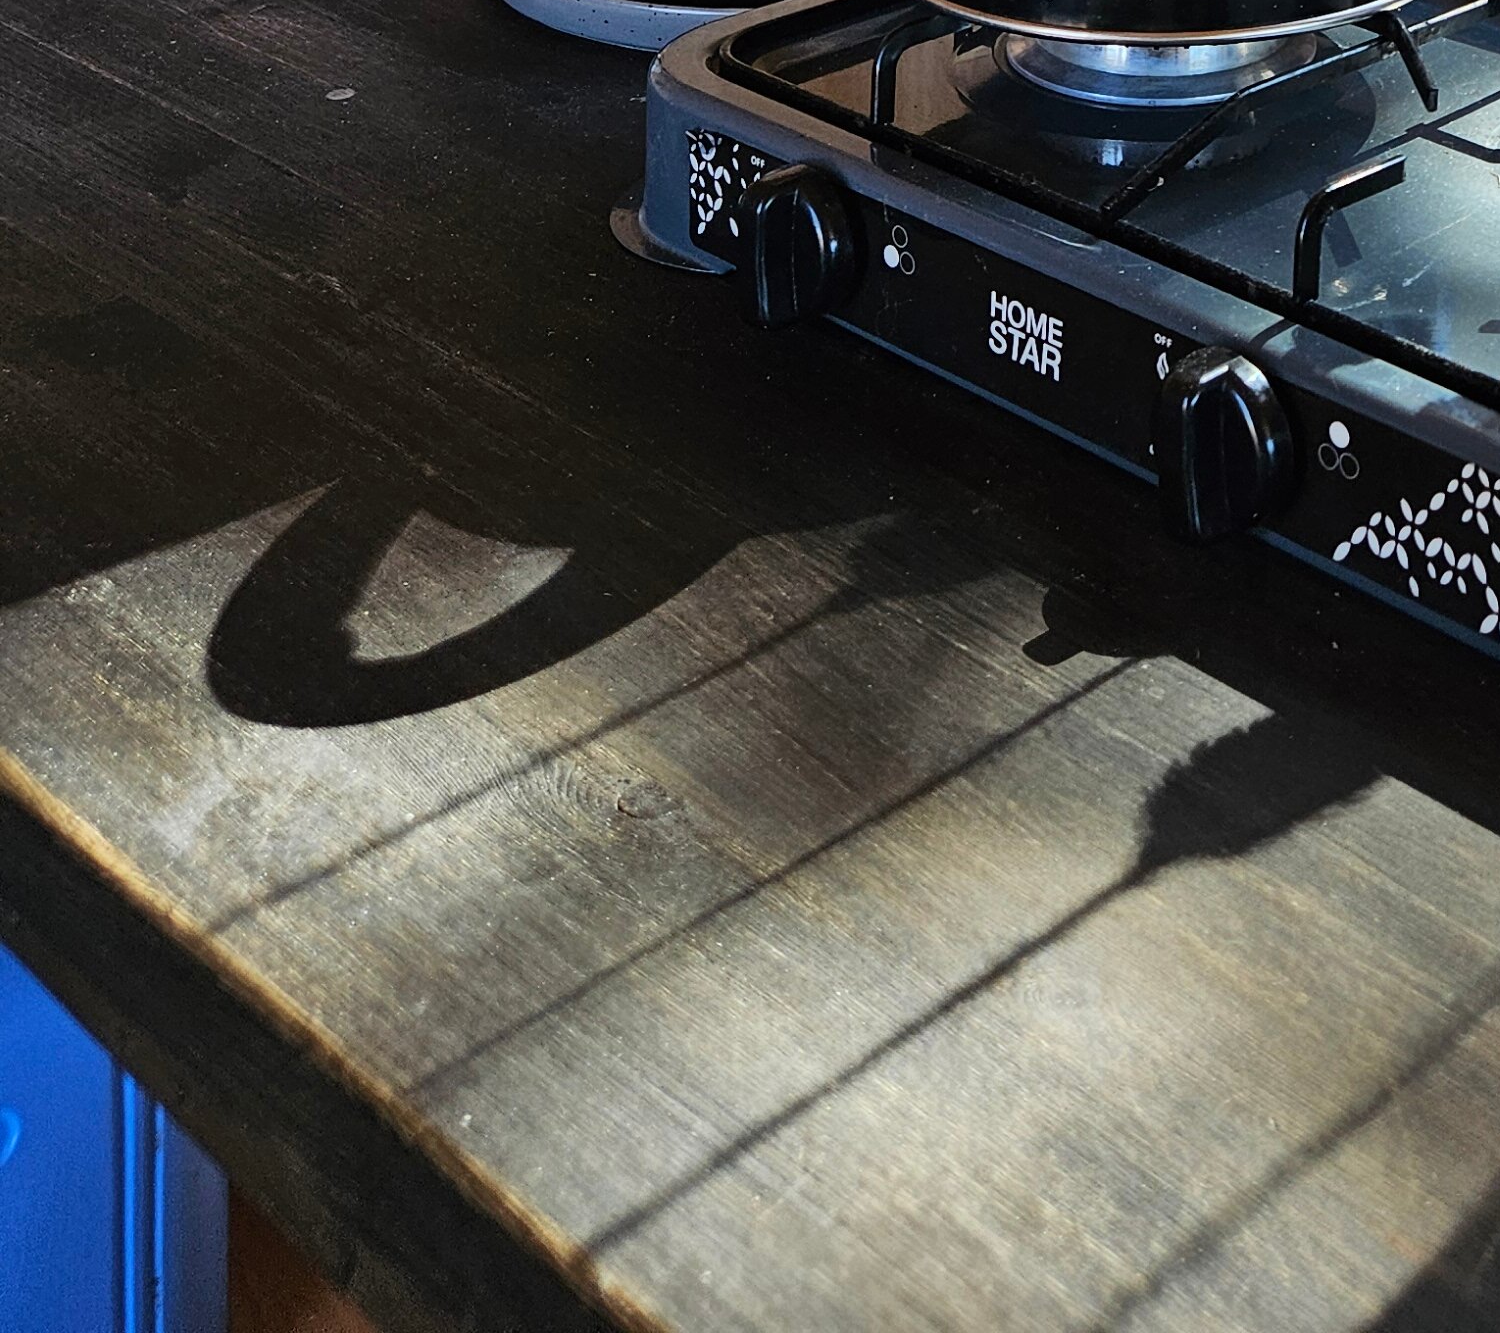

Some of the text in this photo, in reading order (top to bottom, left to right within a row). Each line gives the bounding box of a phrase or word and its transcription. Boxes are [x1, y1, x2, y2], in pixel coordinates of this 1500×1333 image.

[751, 155, 765, 168] OFF
[990, 290, 1064, 348] HOME
[988, 320, 1062, 382] STAR
[1154, 332, 1173, 348] OFF
